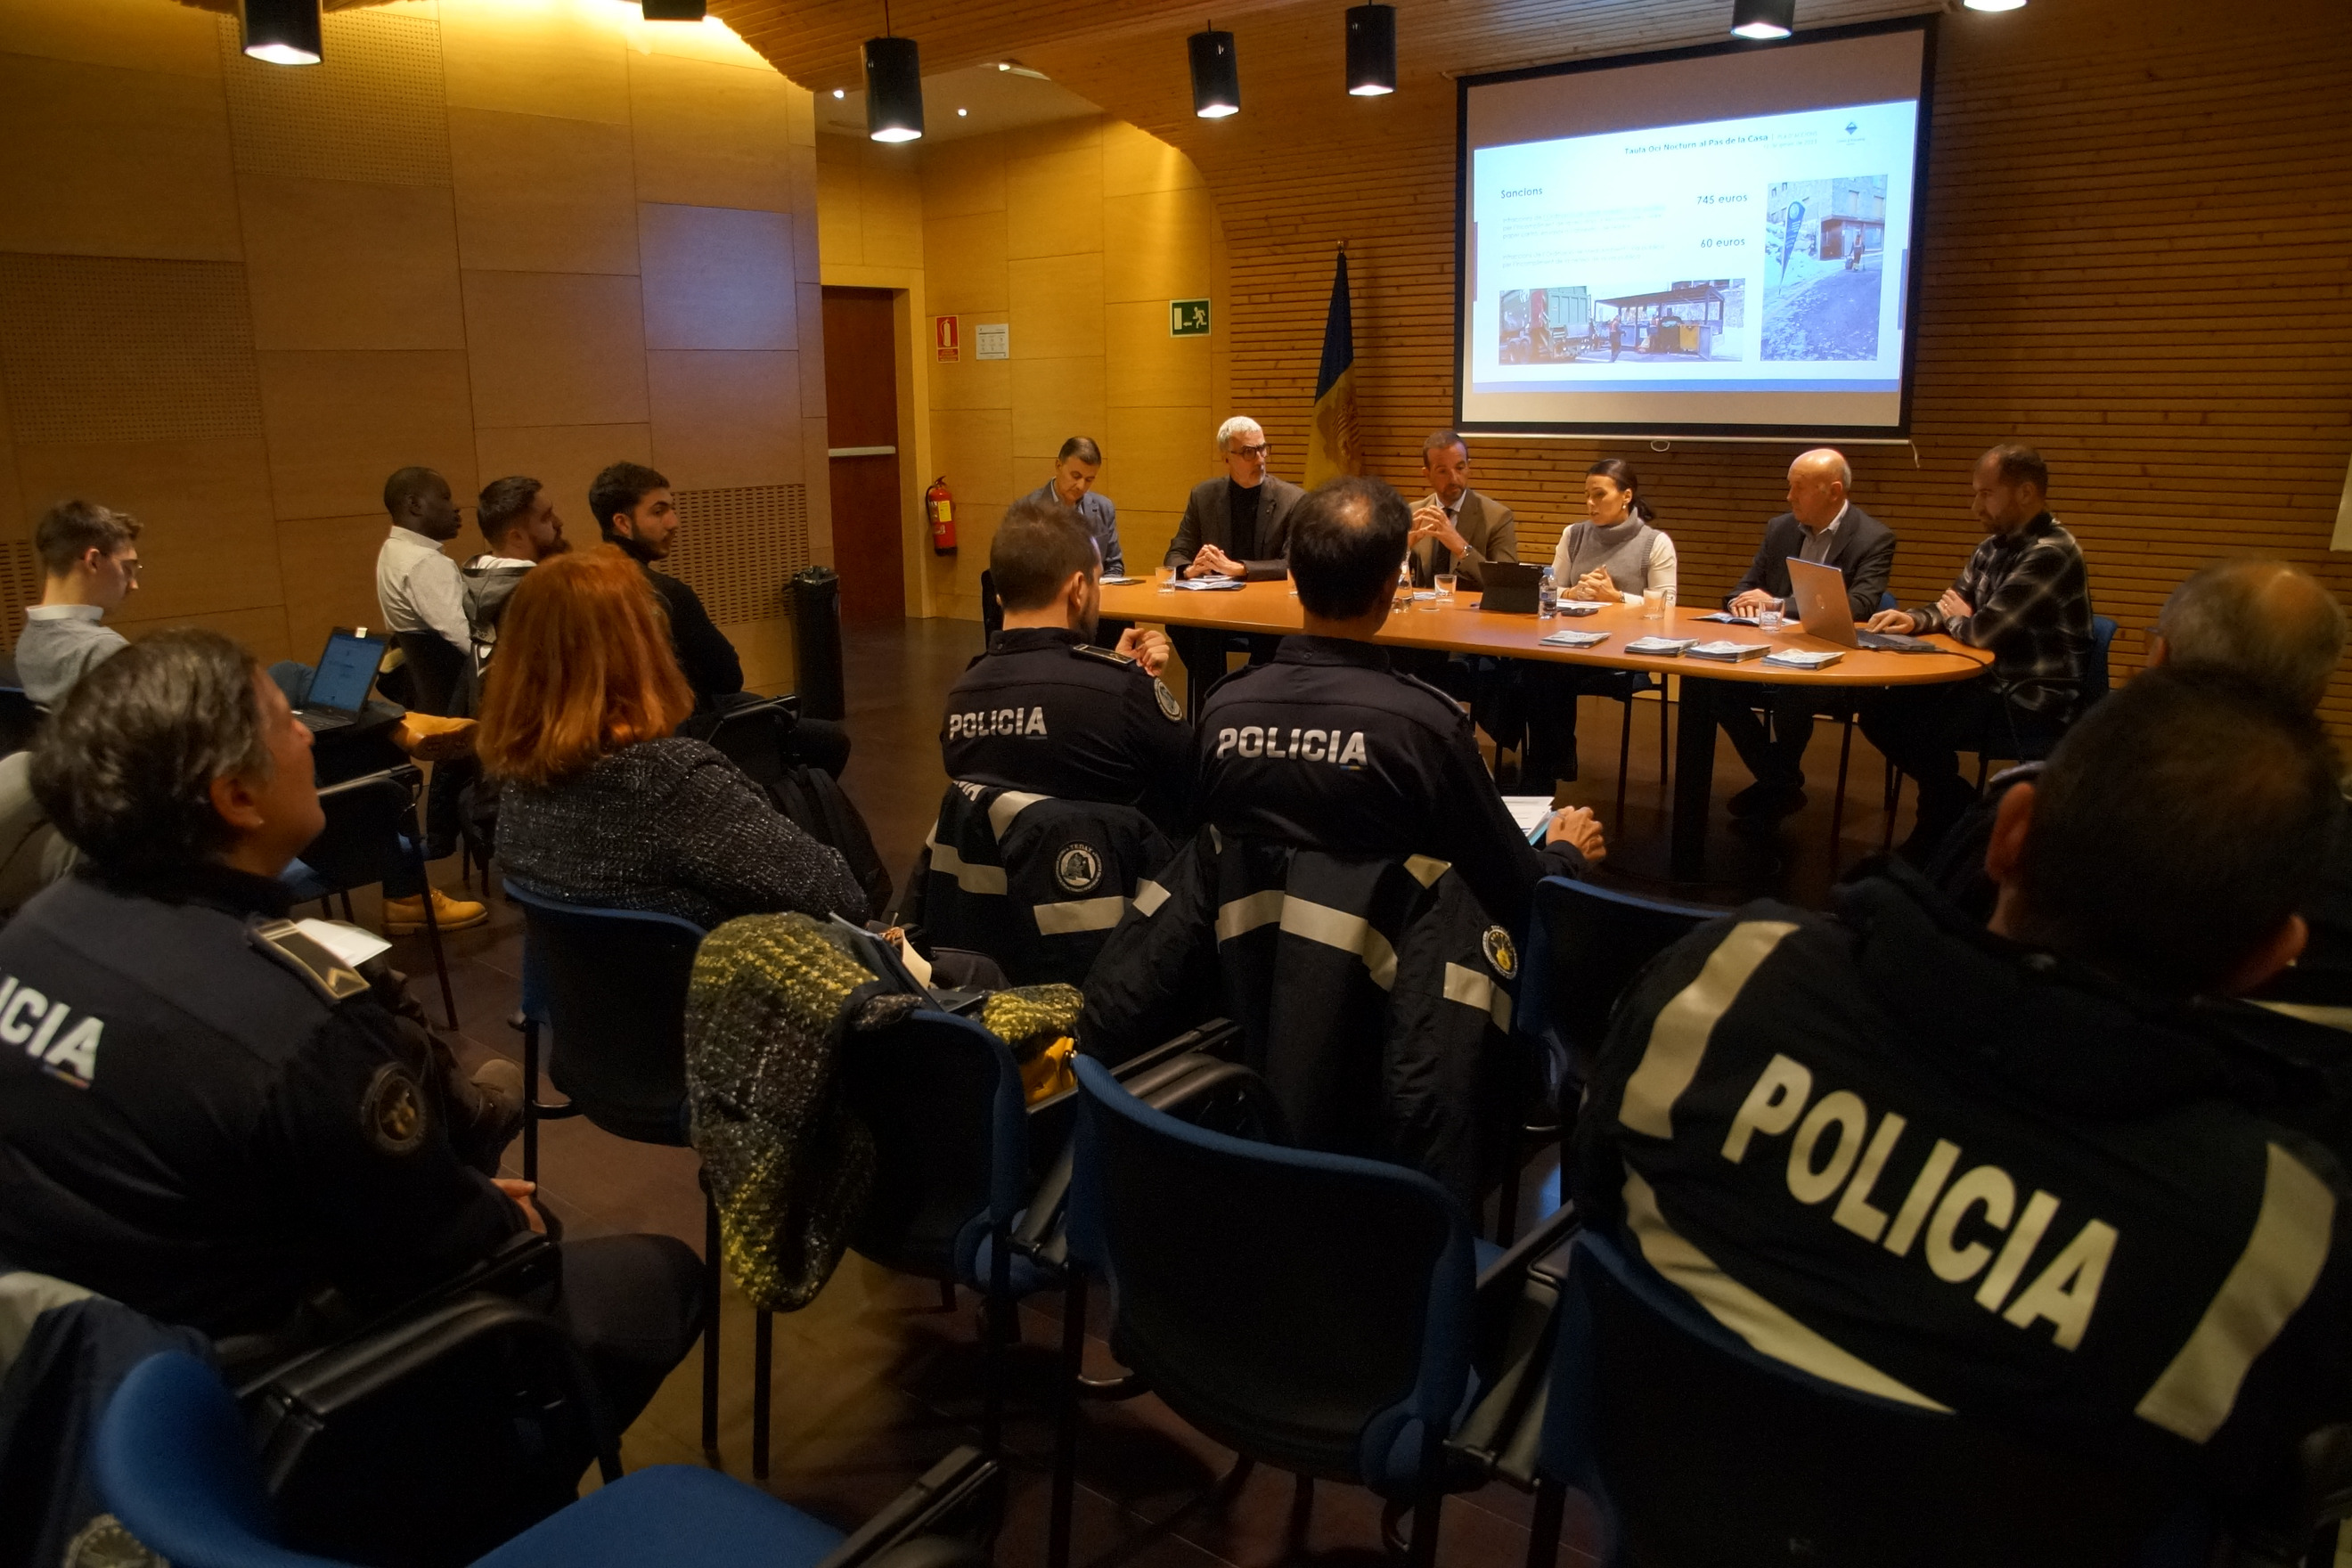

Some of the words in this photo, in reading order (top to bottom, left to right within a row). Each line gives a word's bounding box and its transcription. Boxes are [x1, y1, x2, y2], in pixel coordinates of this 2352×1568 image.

[1663, 142, 1697, 151] Nocturn
[1708, 138, 1723, 146] Pas
[1737, 135, 1746, 143] la
[1747, 135, 1768, 143] Casa
[1500, 187, 1543, 200] Sancions
[1696, 194, 1715, 205] 745
[1718, 194, 1748, 204] euros
[1700, 238, 1713, 249] 60
[1716, 238, 1746, 248] euros
[949, 706, 1048, 740] POLICIA
[1216, 725, 1368, 765] POLICIA
[0, 975, 105, 1081] ICIA
[1720, 1052, 2120, 1353] POLICIA
